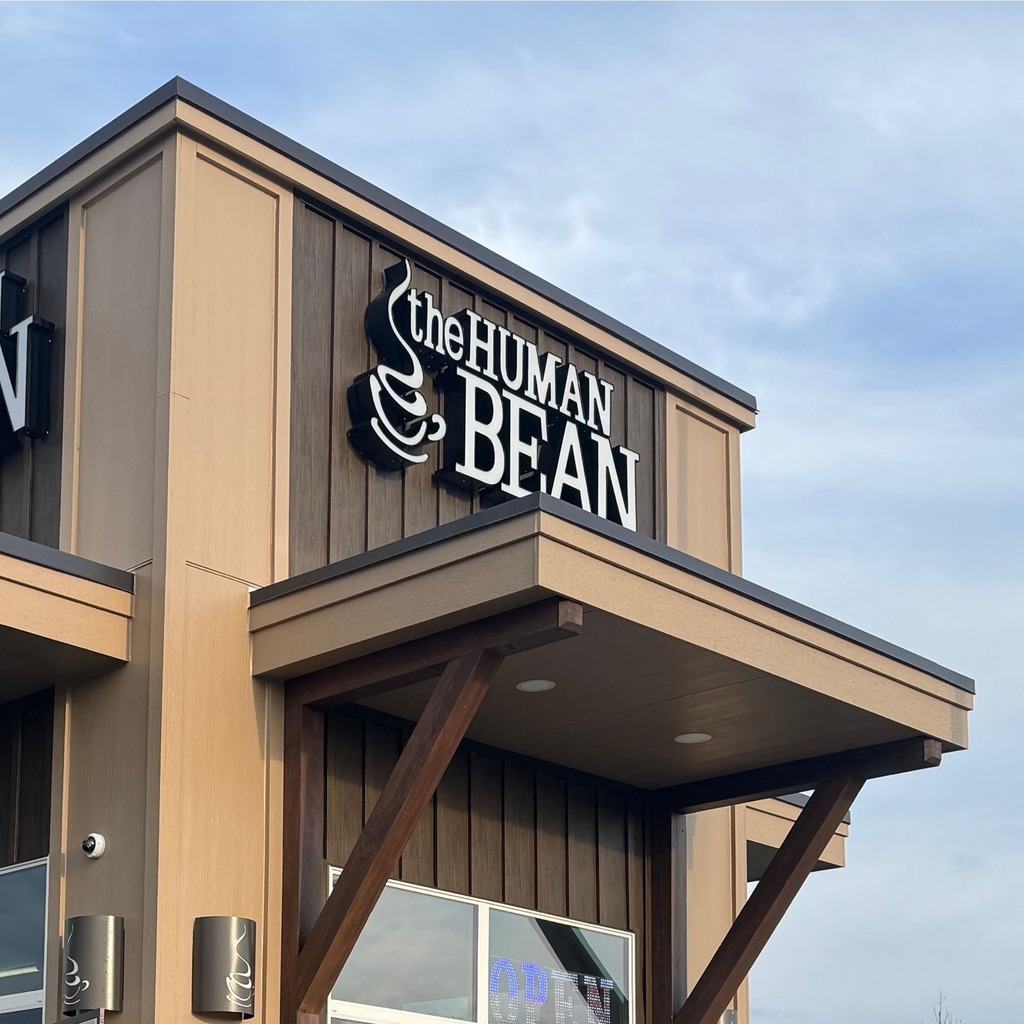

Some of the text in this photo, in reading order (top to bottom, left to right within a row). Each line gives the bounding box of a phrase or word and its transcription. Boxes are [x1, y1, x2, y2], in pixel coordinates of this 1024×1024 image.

[407, 288, 614, 437] the HUMAN
[455, 366, 640, 532] BEAN
